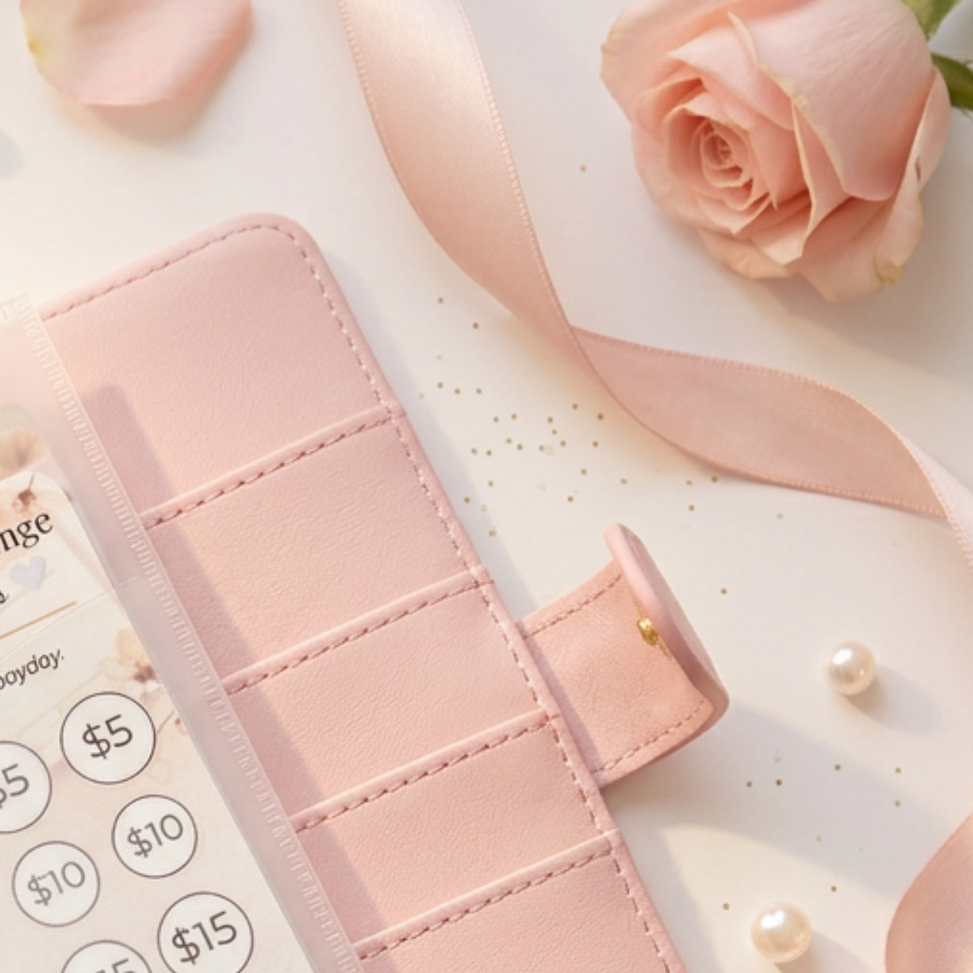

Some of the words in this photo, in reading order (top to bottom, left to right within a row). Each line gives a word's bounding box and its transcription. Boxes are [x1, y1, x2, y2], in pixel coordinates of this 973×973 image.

[82, 714, 133, 760] $5
[27, 861, 85, 906] $10
[127, 814, 183, 858] $10
[172, 910, 237, 966] $15
